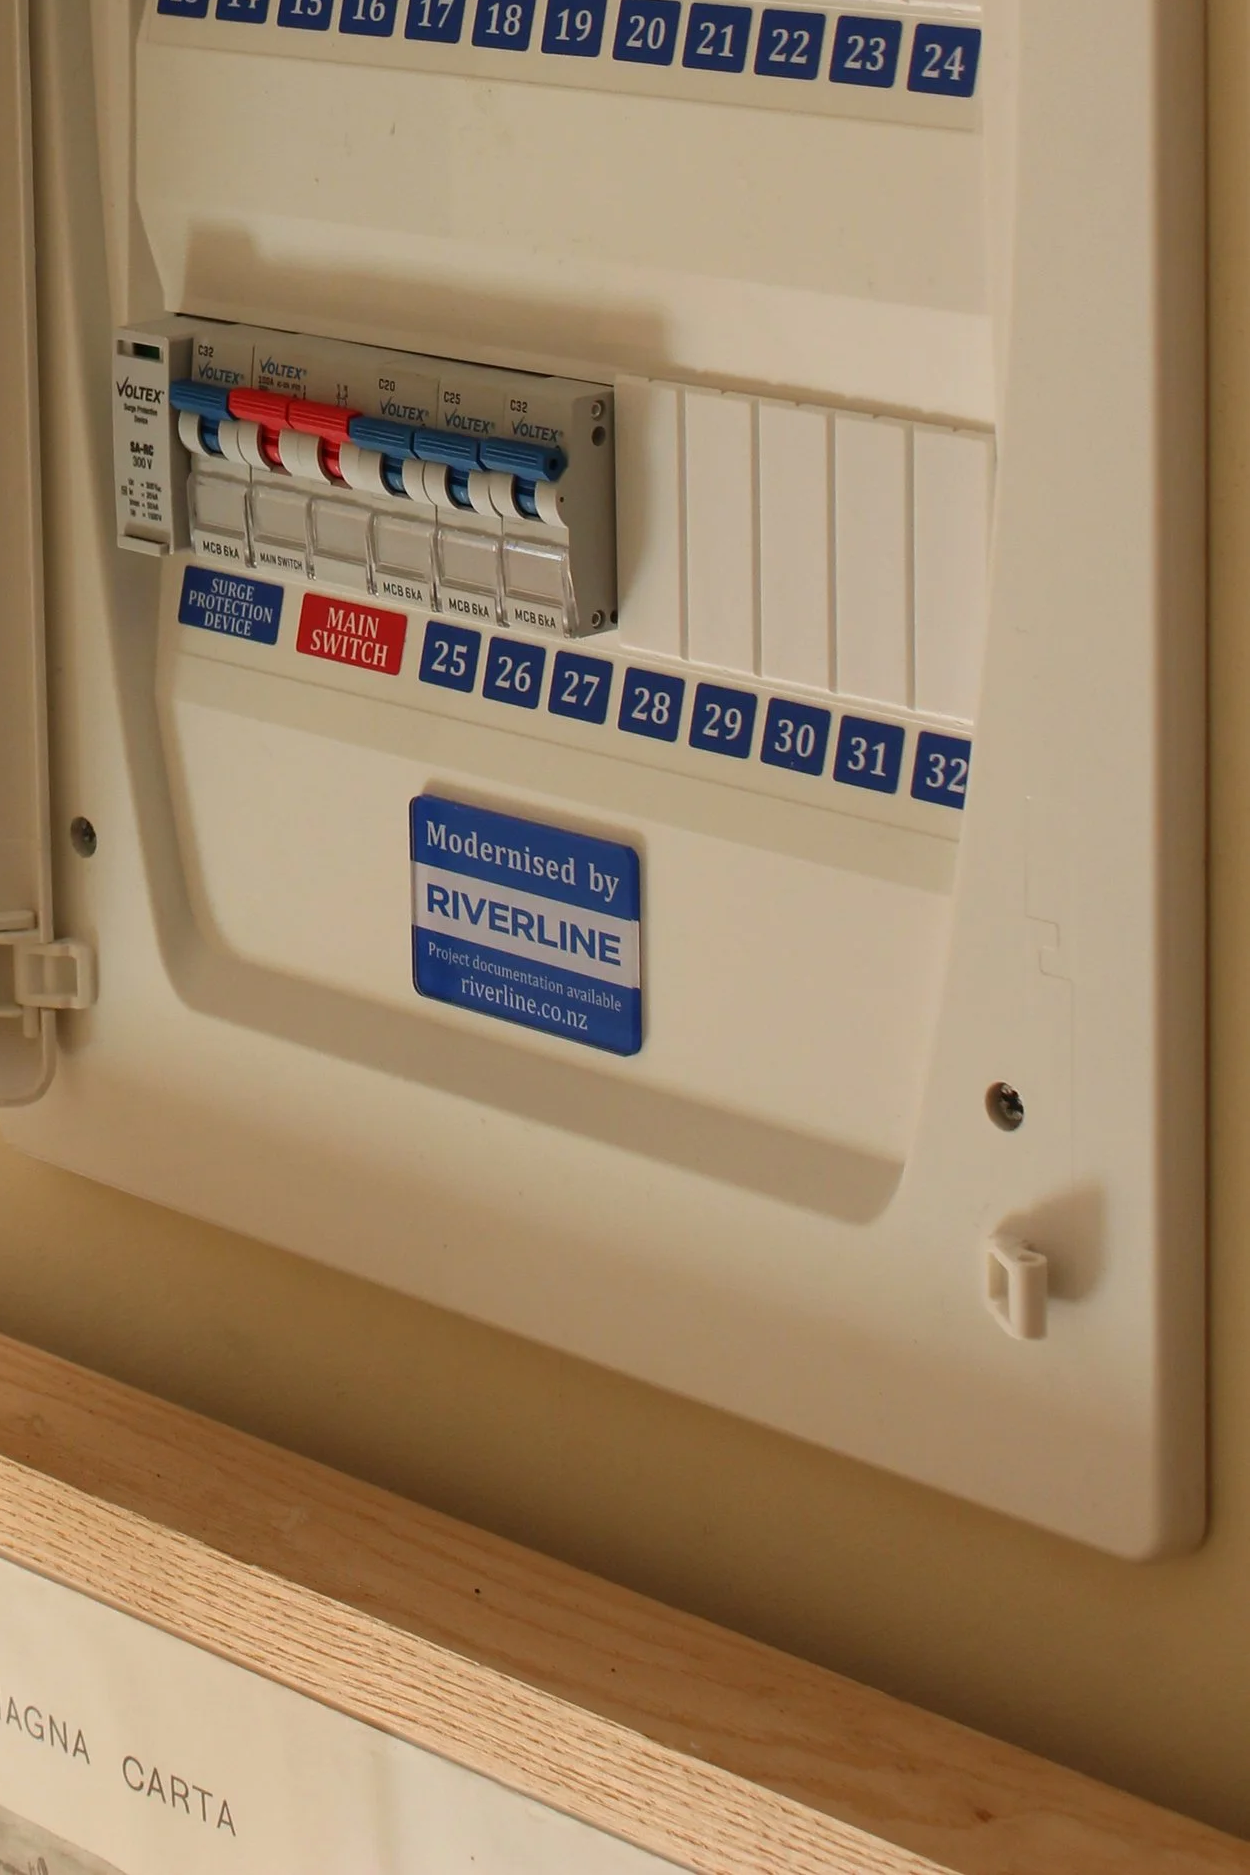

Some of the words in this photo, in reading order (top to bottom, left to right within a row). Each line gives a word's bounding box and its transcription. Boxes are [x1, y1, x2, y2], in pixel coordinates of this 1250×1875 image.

[626, 15, 665, 49] 20
[922, 43, 965, 80] 24
[188, 589, 273, 624] PROTECTION
[211, 577, 254, 602] SURGE
[204, 611, 252, 637] DEVICE
[327, 606, 380, 639] MAIN
[310, 629, 389, 667] SWITCH
[432, 640, 466, 677] 25
[631, 687, 671, 725] 28
[925, 752, 967, 795] 32
[426, 821, 576, 886] Modernised
[588, 862, 620, 903] by
[427, 883, 621, 966] RIVERLINE
[428, 941, 470, 968] Project
[472, 954, 564, 995] documentation
[567, 986, 622, 1012] available
[461, 976, 588, 1031] riverline.co.nz
[122, 1755, 237, 1837] CARTA
